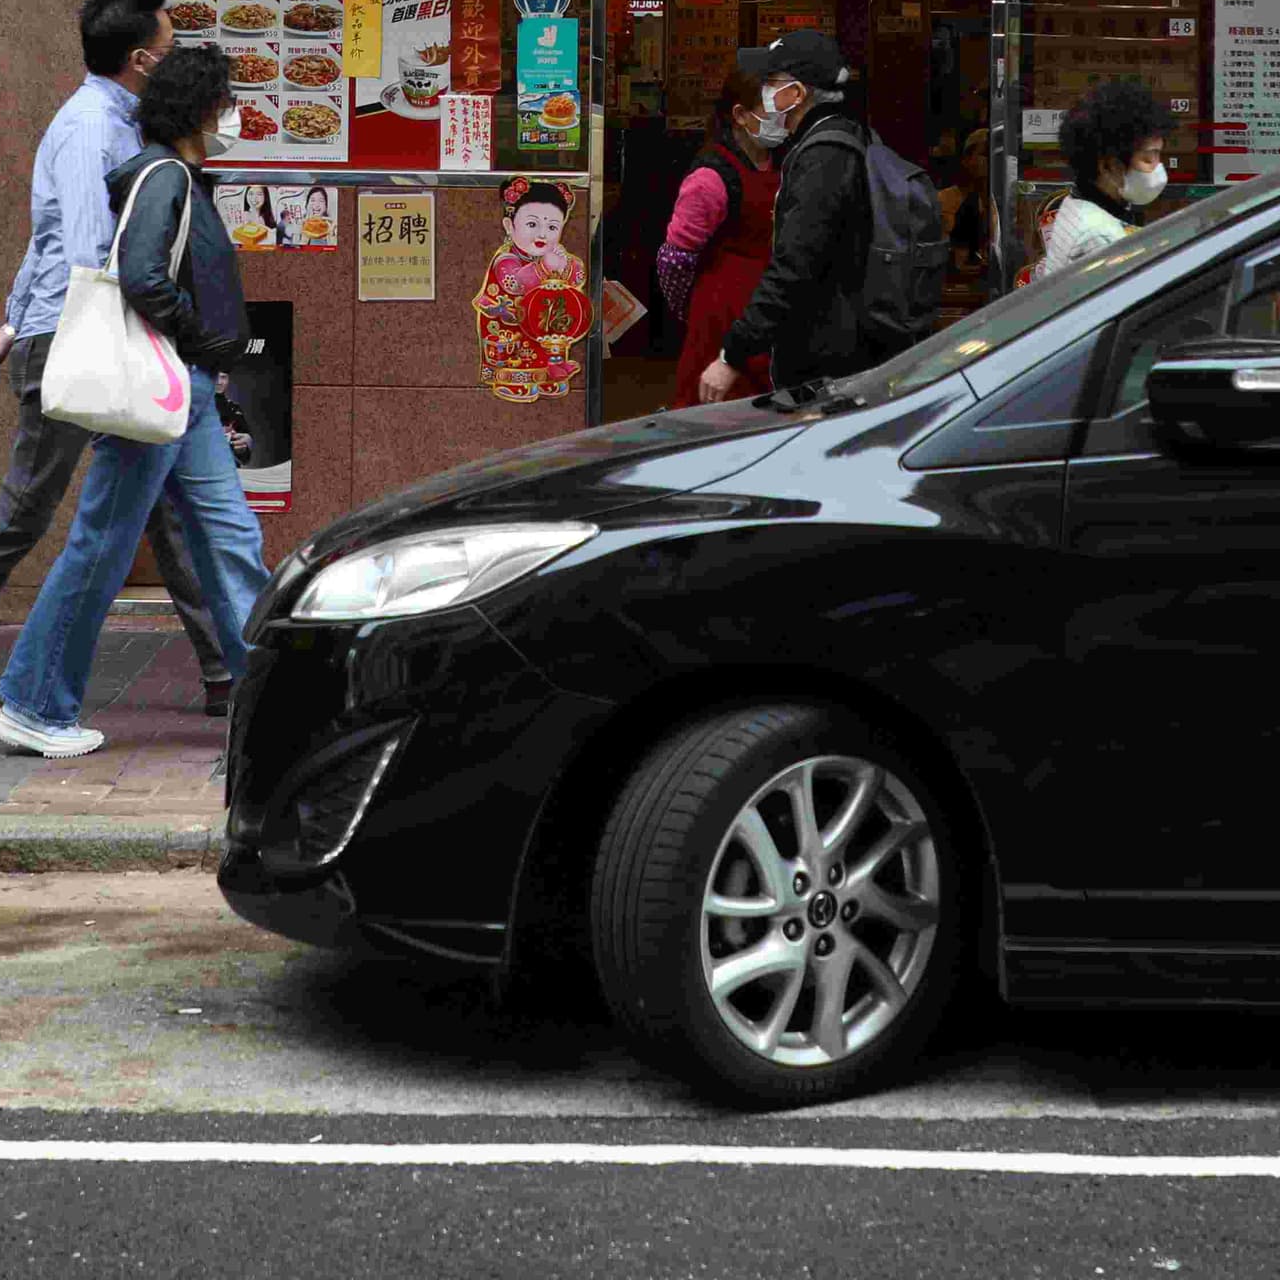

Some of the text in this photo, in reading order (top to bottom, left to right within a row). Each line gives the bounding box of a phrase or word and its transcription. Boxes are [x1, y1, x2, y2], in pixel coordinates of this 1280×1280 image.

[1171, 21, 1192, 34] 48
[1171, 101, 1189, 111] 49
[363, 212, 430, 246] 招聘
[542, 295, 572, 332] 福
